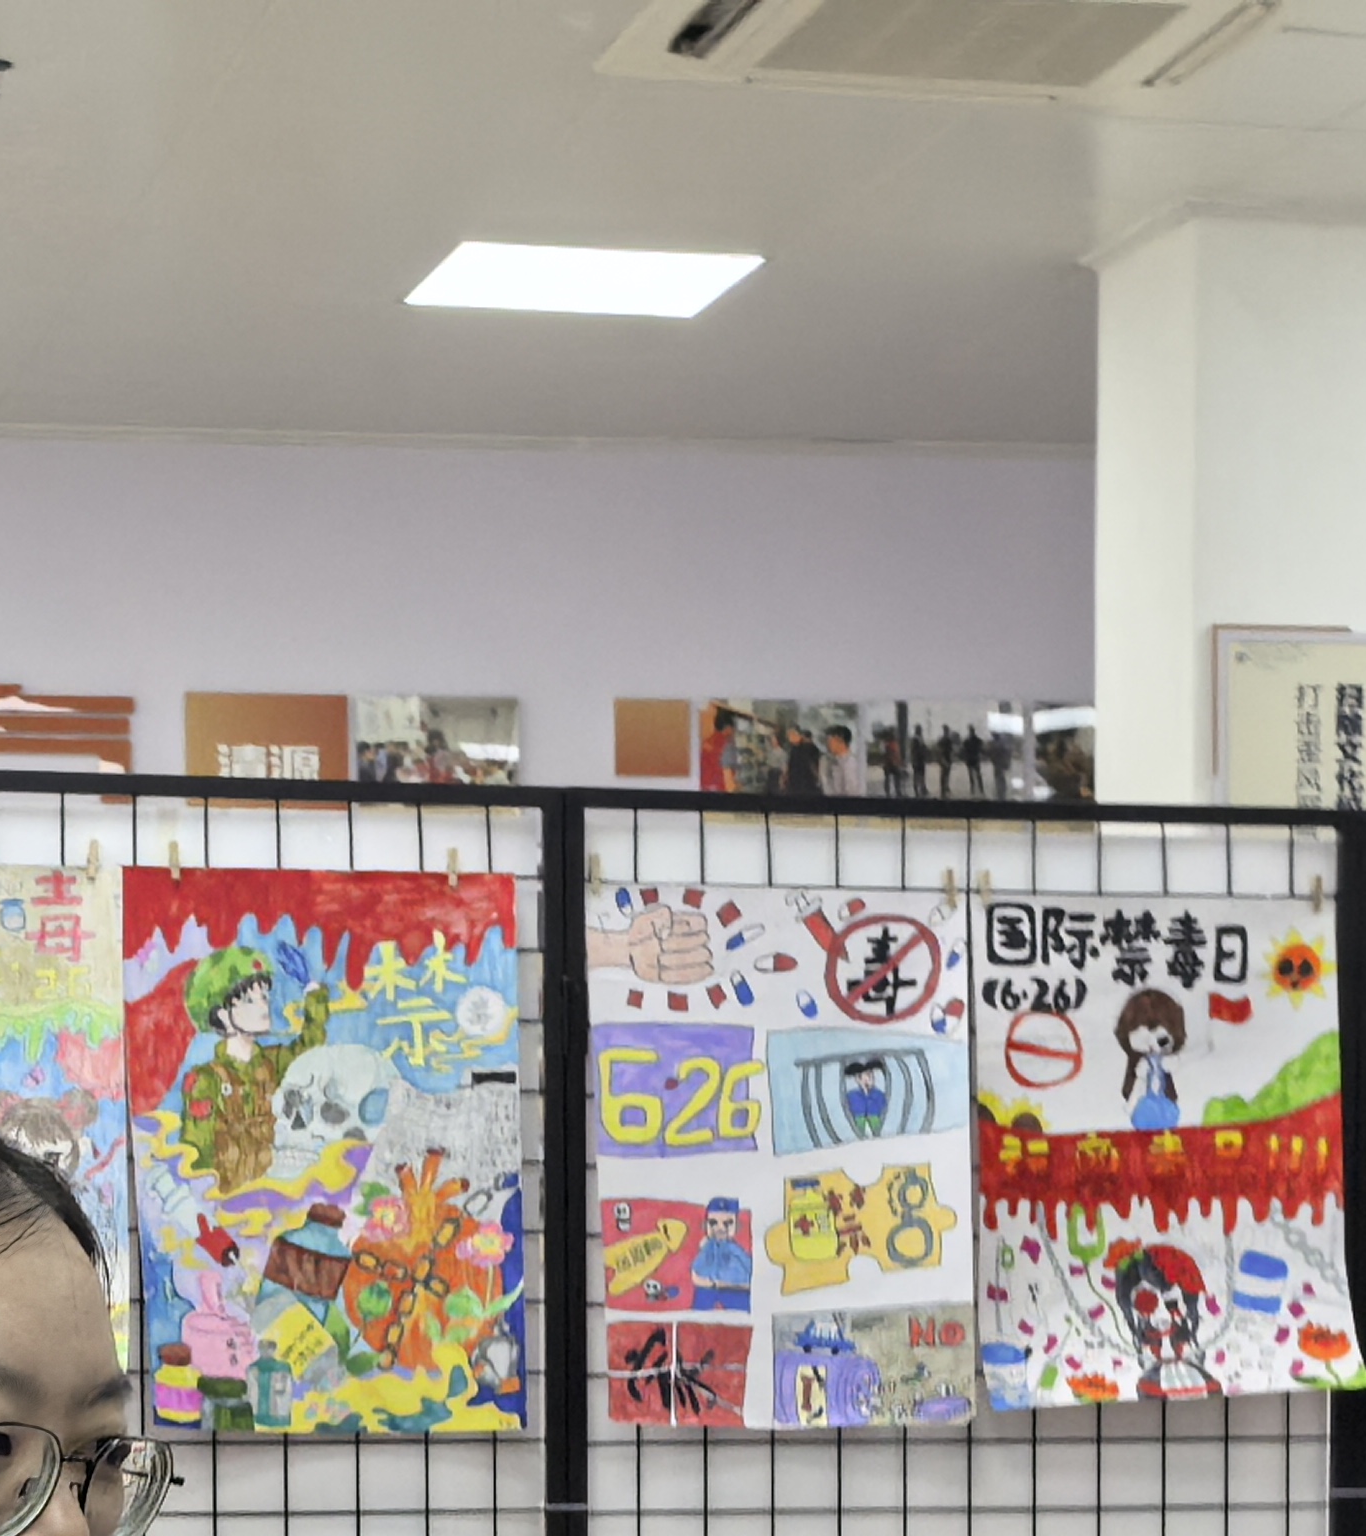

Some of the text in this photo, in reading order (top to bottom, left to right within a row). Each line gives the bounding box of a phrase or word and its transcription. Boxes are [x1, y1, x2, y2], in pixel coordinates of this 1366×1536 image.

[985, 902, 1249, 990] 国际禁毒日
[908, 1316, 967, 1348] NO
